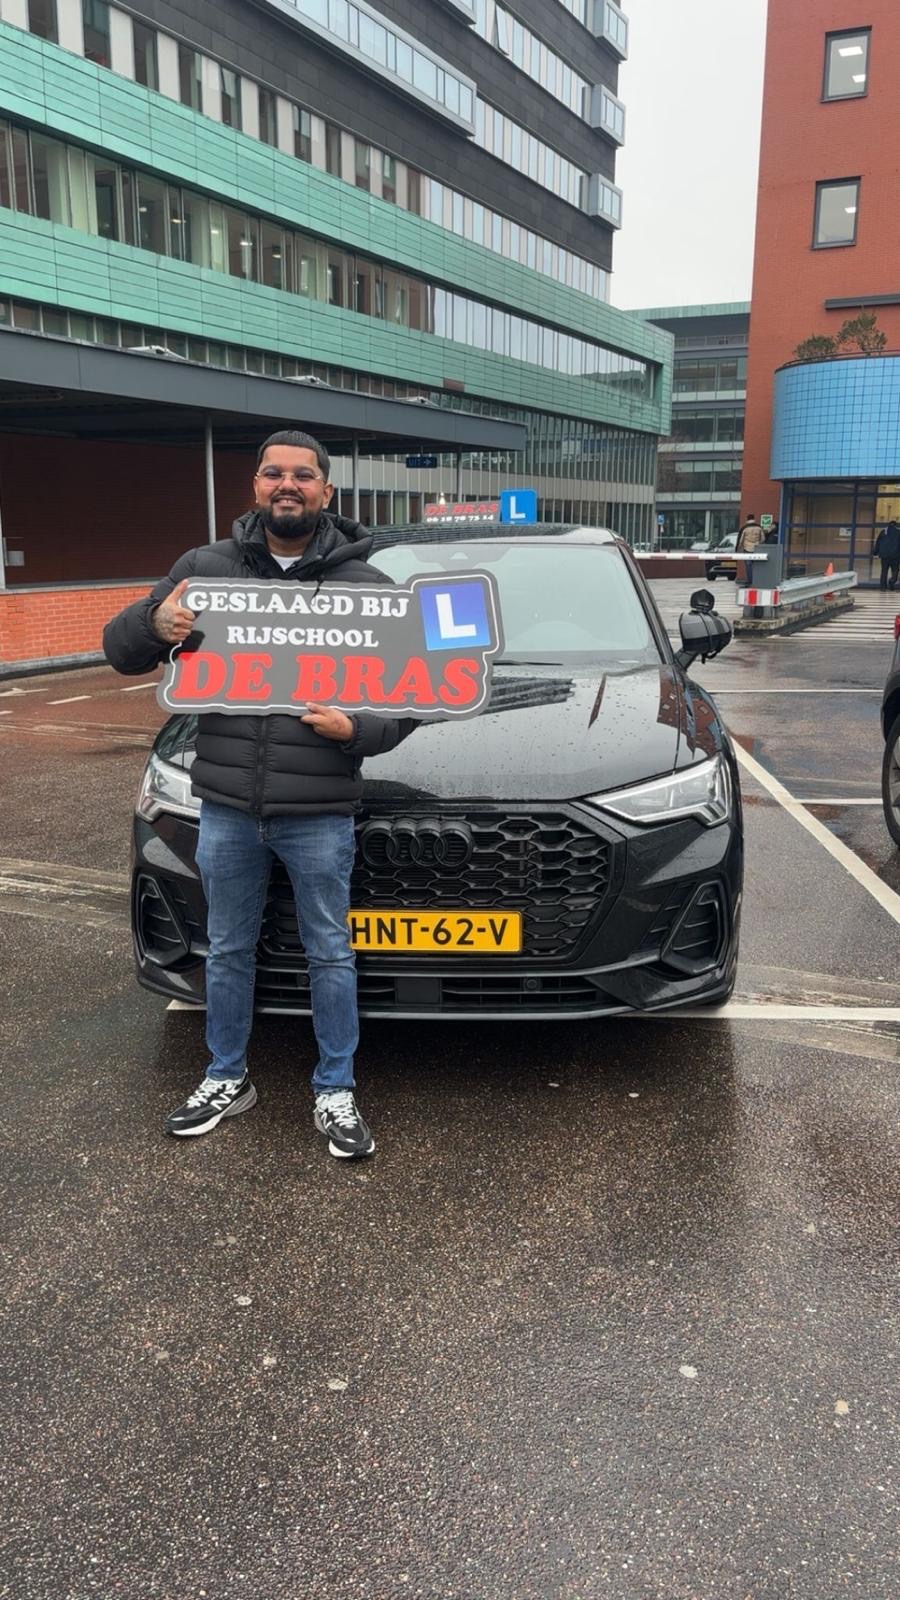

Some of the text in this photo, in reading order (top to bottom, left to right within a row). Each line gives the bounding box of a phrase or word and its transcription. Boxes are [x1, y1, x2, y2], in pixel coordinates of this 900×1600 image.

[510, 496, 526, 519] L
[186, 591, 409, 618] GESLAAGD BIJ
[435, 593, 477, 639] L
[227, 626, 379, 648] RIJSCHOOL
[172, 651, 481, 706] DE BRAS
[351, 917, 508, 946] HNT-62-V
